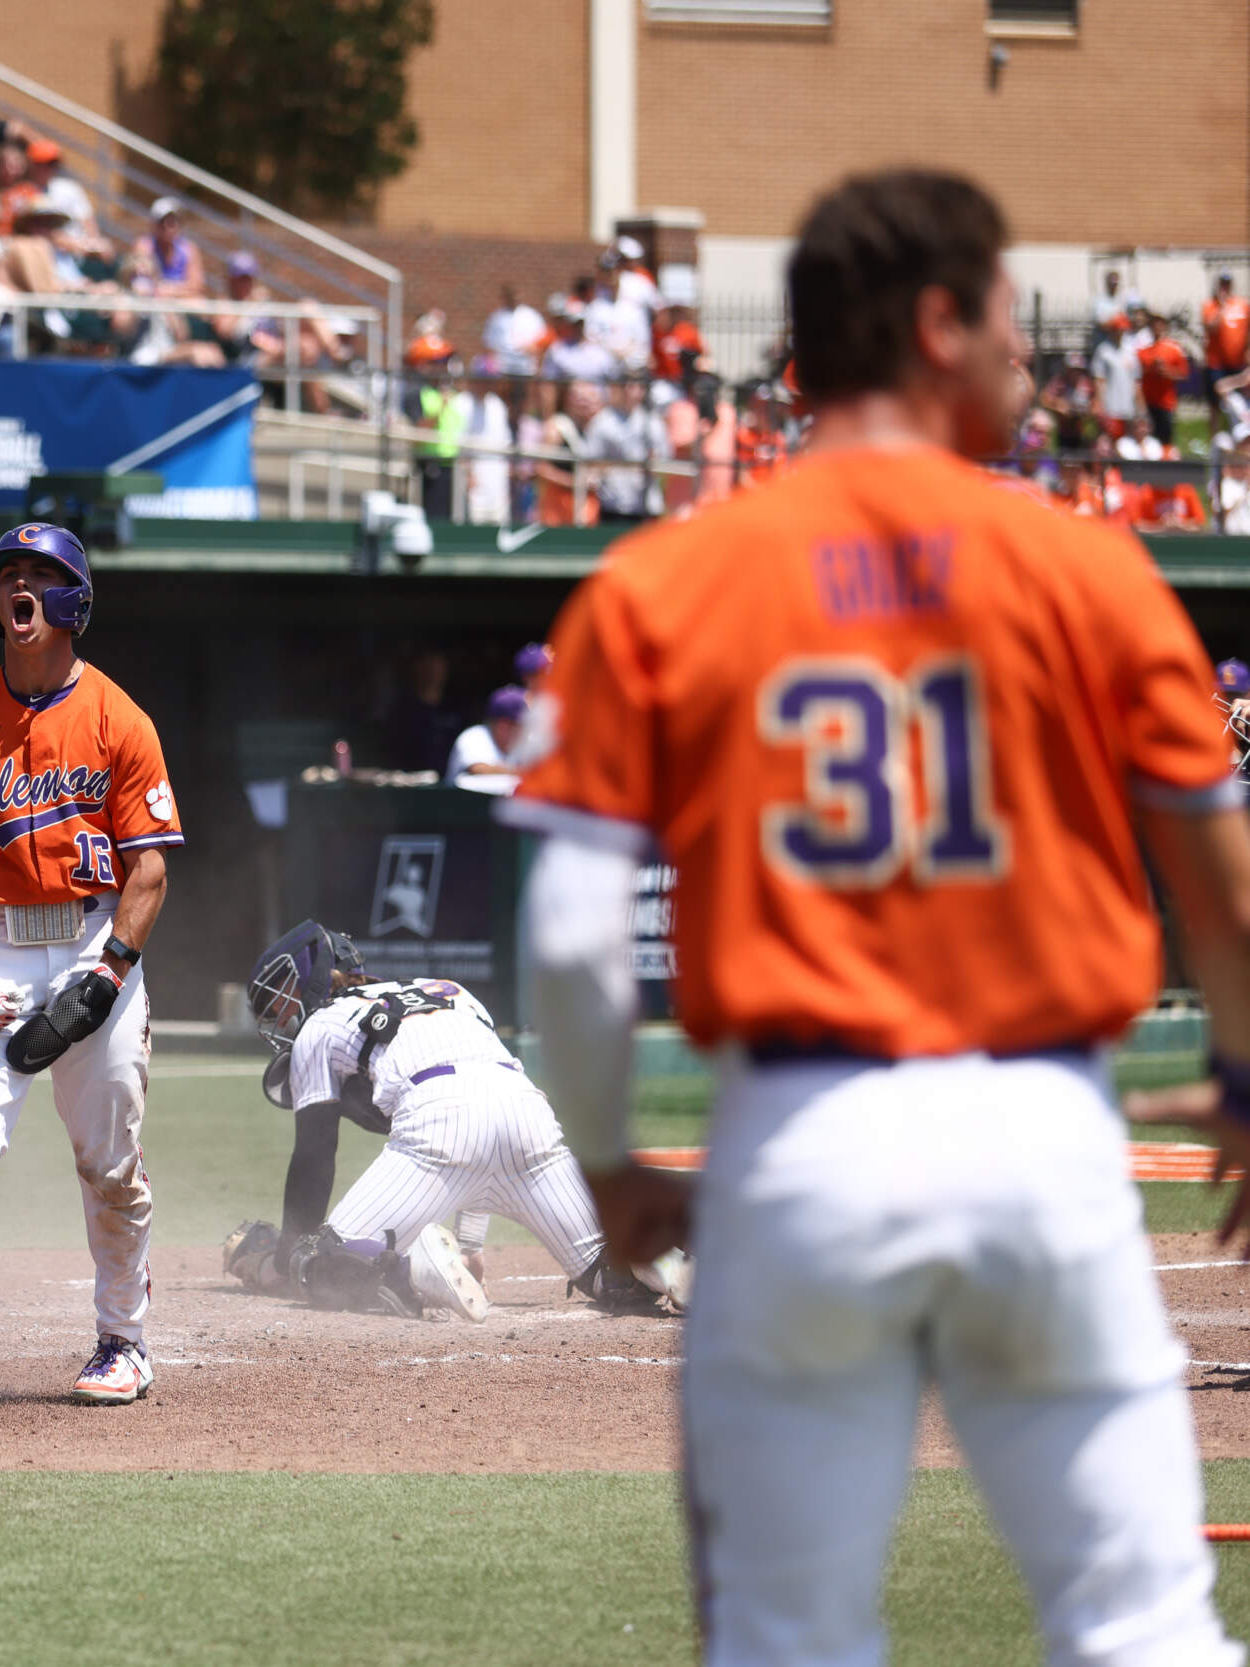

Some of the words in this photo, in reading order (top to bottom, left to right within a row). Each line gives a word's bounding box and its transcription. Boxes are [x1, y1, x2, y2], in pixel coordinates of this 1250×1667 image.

[18, 526, 41, 544] C
[756, 653, 1013, 891] 31
[70, 830, 116, 884] 16
